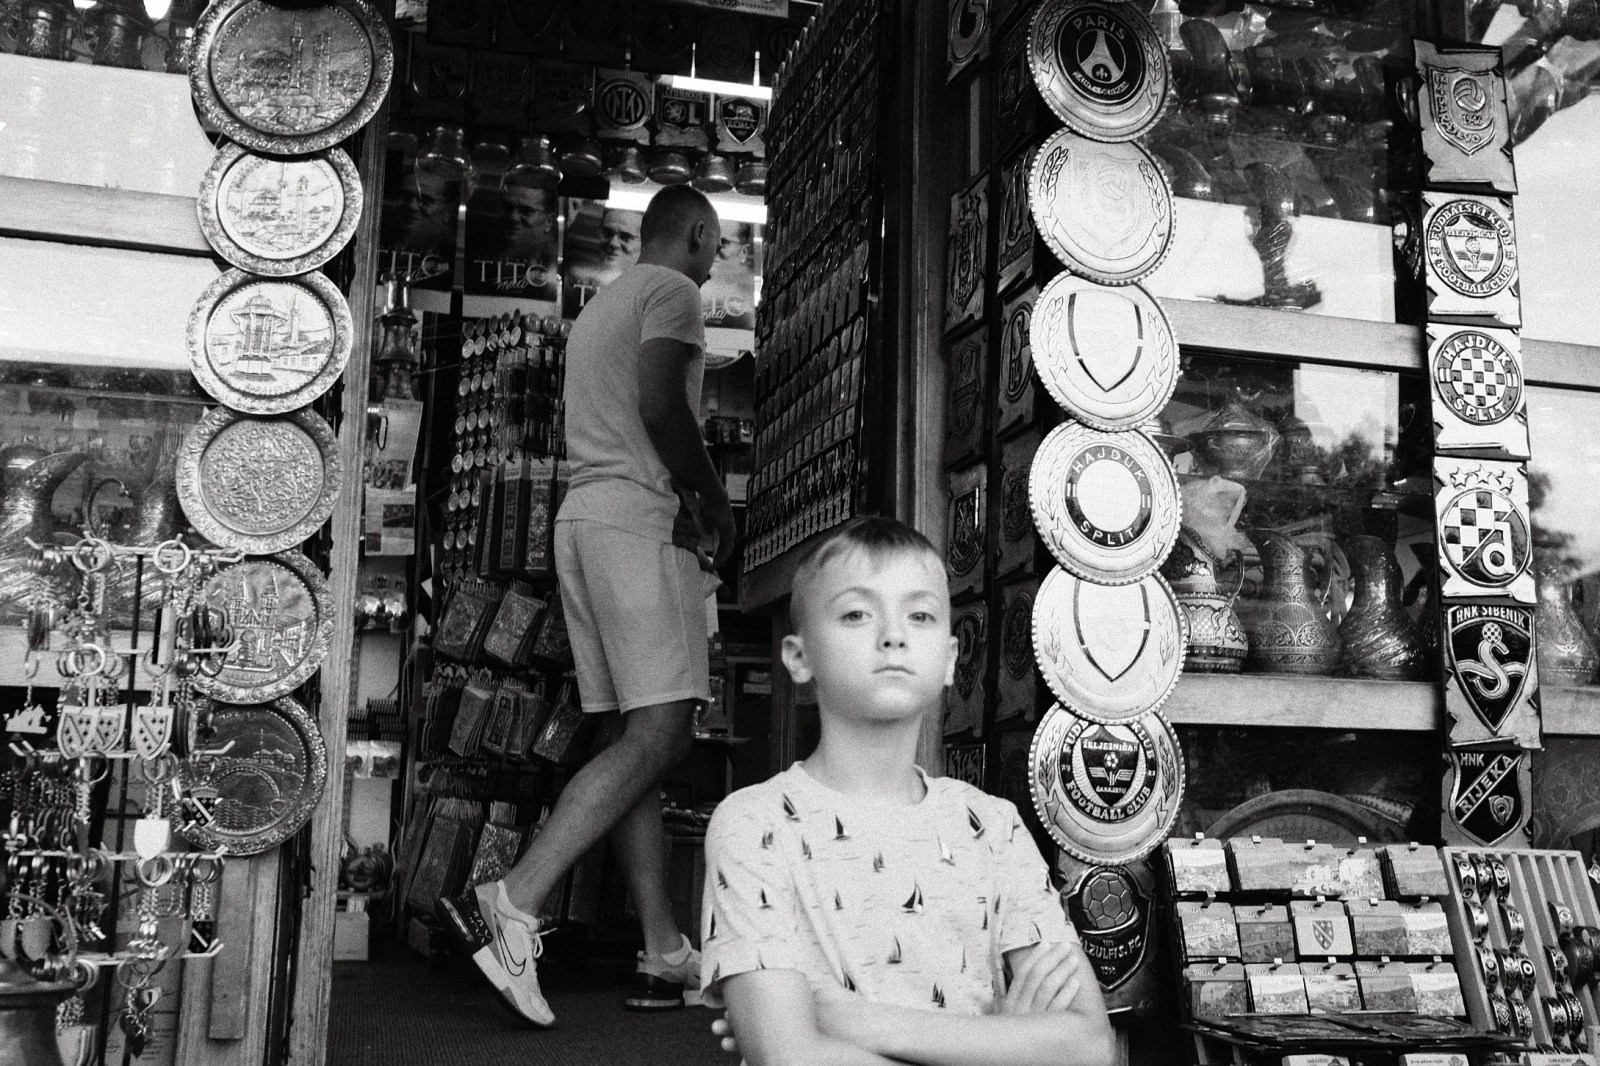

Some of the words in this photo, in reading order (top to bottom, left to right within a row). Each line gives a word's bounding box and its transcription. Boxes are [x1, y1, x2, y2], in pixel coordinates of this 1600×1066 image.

[1072, 15, 1127, 41] PARIS
[726, 118, 755, 130] ROMA
[1429, 203, 1487, 241] FUDBALSKI
[1487, 212, 1512, 246] KLUB
[473, 258, 549, 288] TITO
[1435, 259, 1490, 294] FOOTBALL
[1490, 265, 1512, 289] CLUB
[1443, 335, 1511, 367] HAJDUK
[1454, 398, 1506, 421] SPLIT
[1071, 447, 1146, 481] HAJDUK
[1080, 520, 1134, 545] SPLIT
[1456, 605, 1479, 624] HNK
[1130, 721, 1155, 759] KLUB
[1460, 752, 1485, 767] HNK
[1066, 779, 1125, 820] FOOTBALL
[1126, 786, 1151, 815] CLUB
[1459, 755, 1513, 814] RIJEKA
